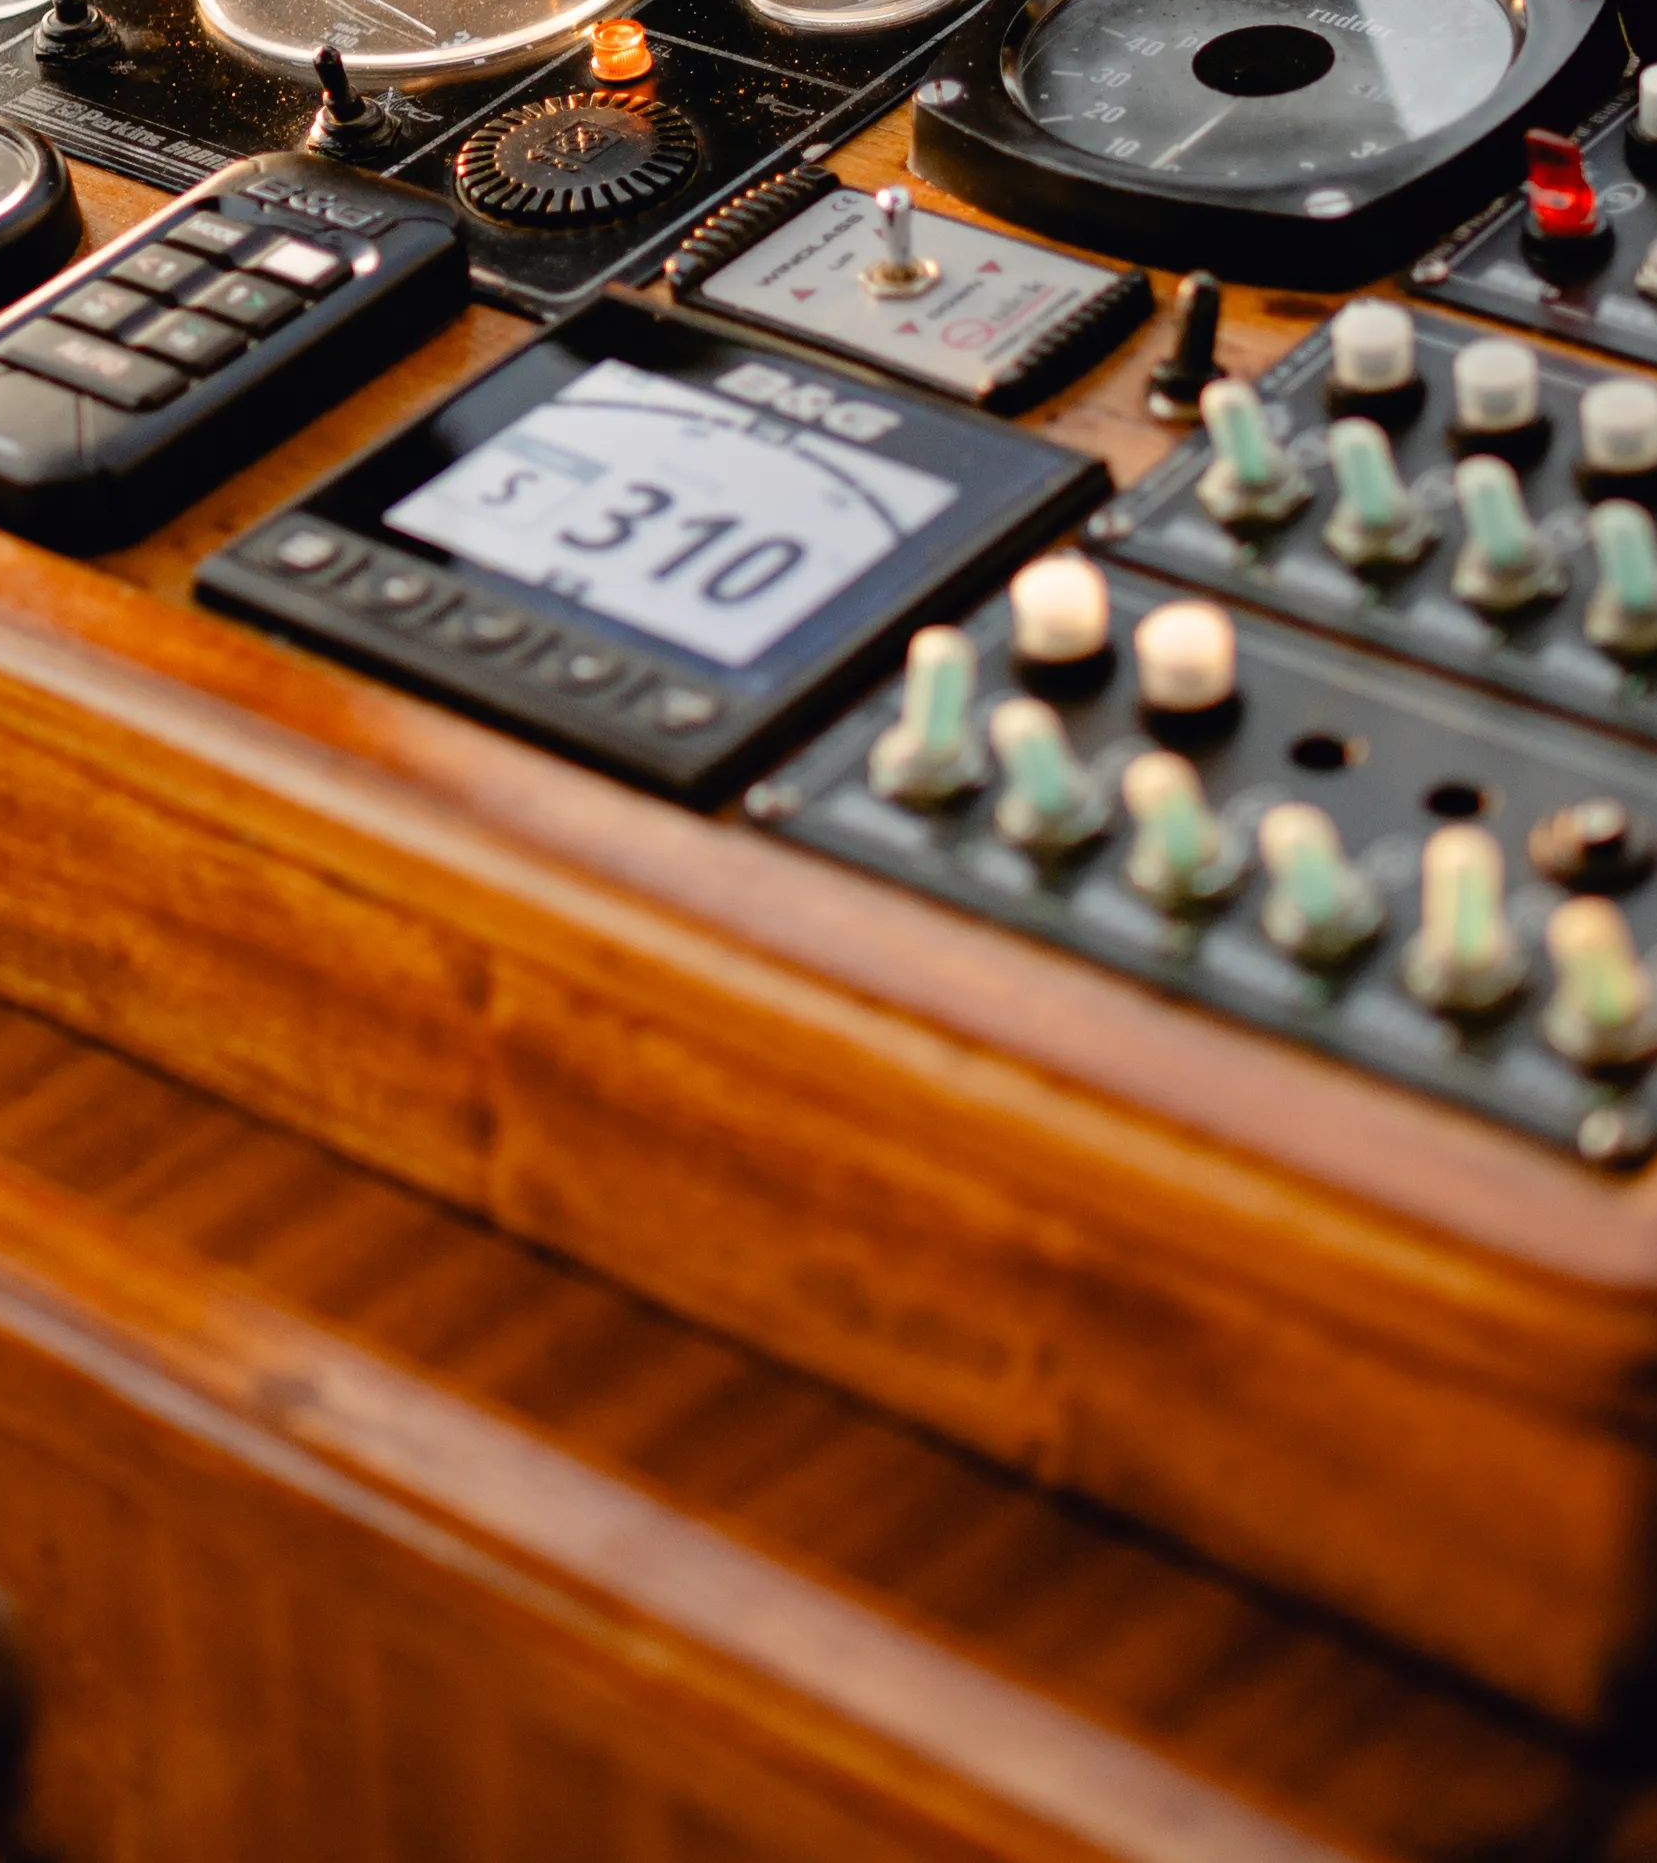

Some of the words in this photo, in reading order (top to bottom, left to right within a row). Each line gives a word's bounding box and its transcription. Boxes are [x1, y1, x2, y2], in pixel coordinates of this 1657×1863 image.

[1307, 8, 1393, 39] rudder
[1123, 35, 1167, 58] 40
[1089, 67, 1132, 89] 30
[76, 109, 167, 148] Perkins
[1082, 101, 1127, 124] 20
[1104, 136, 1141, 158] 10
[245, 175, 384, 228] B&G
[755, 214, 864, 288] WINDLASS
[714, 362, 902, 442] B&G
[556, 481, 808, 604] 310
